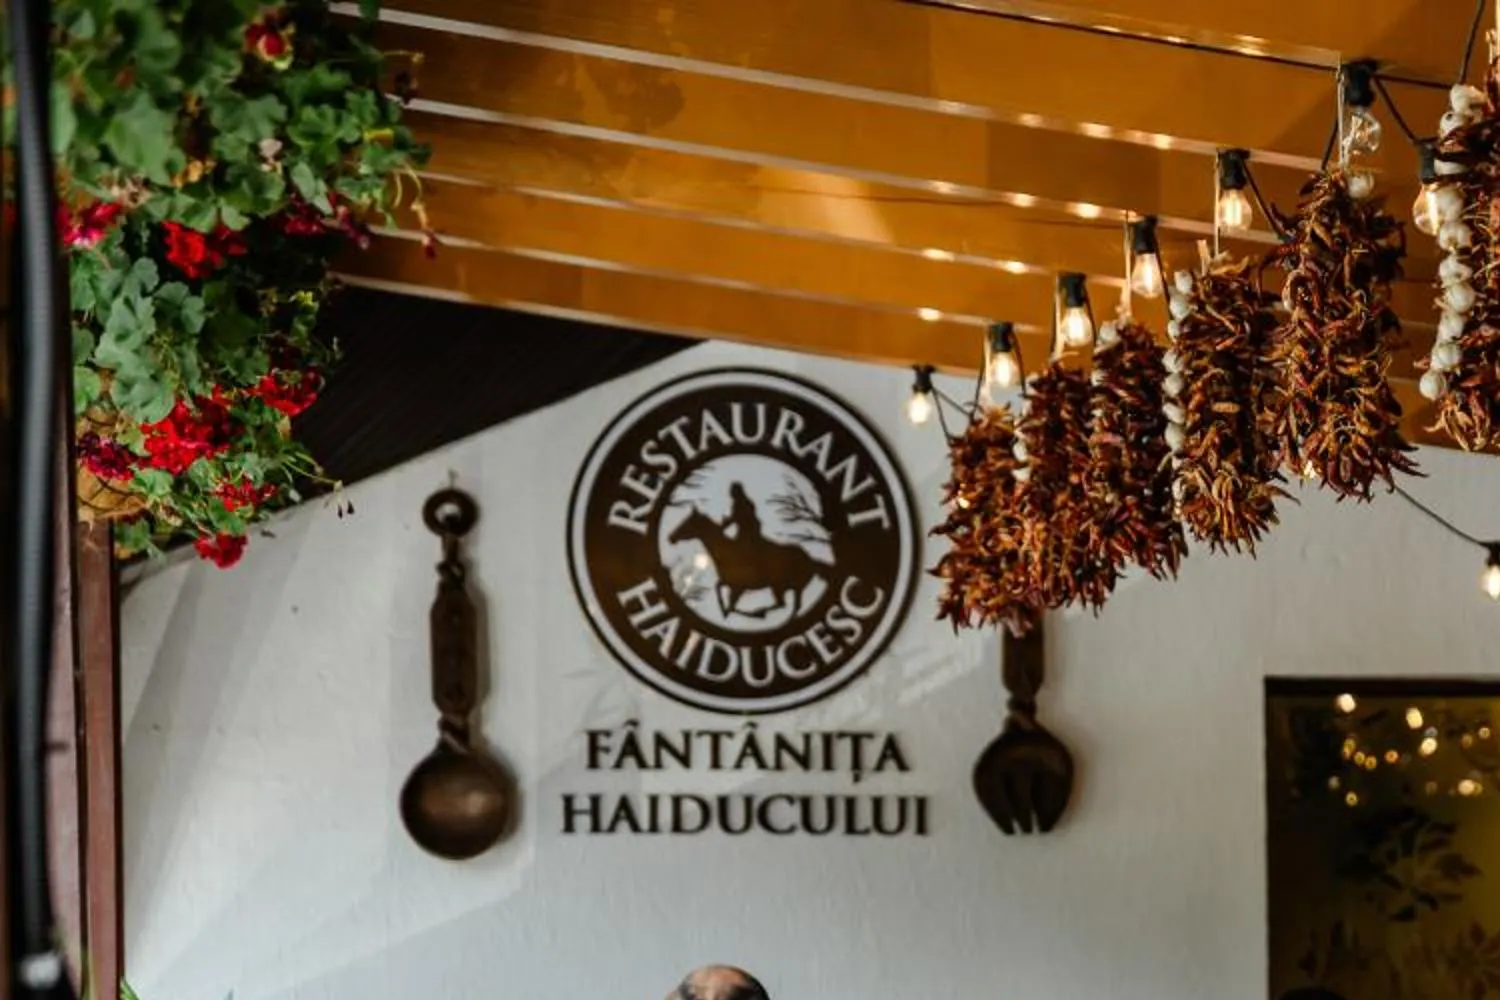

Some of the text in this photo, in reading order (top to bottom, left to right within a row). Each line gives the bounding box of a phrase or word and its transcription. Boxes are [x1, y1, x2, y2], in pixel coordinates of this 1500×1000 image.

[608, 402, 891, 534] RESTAURANT
[618, 576, 884, 688] HAIDUCESC
[561, 794, 931, 836] HAIDUCULUI
